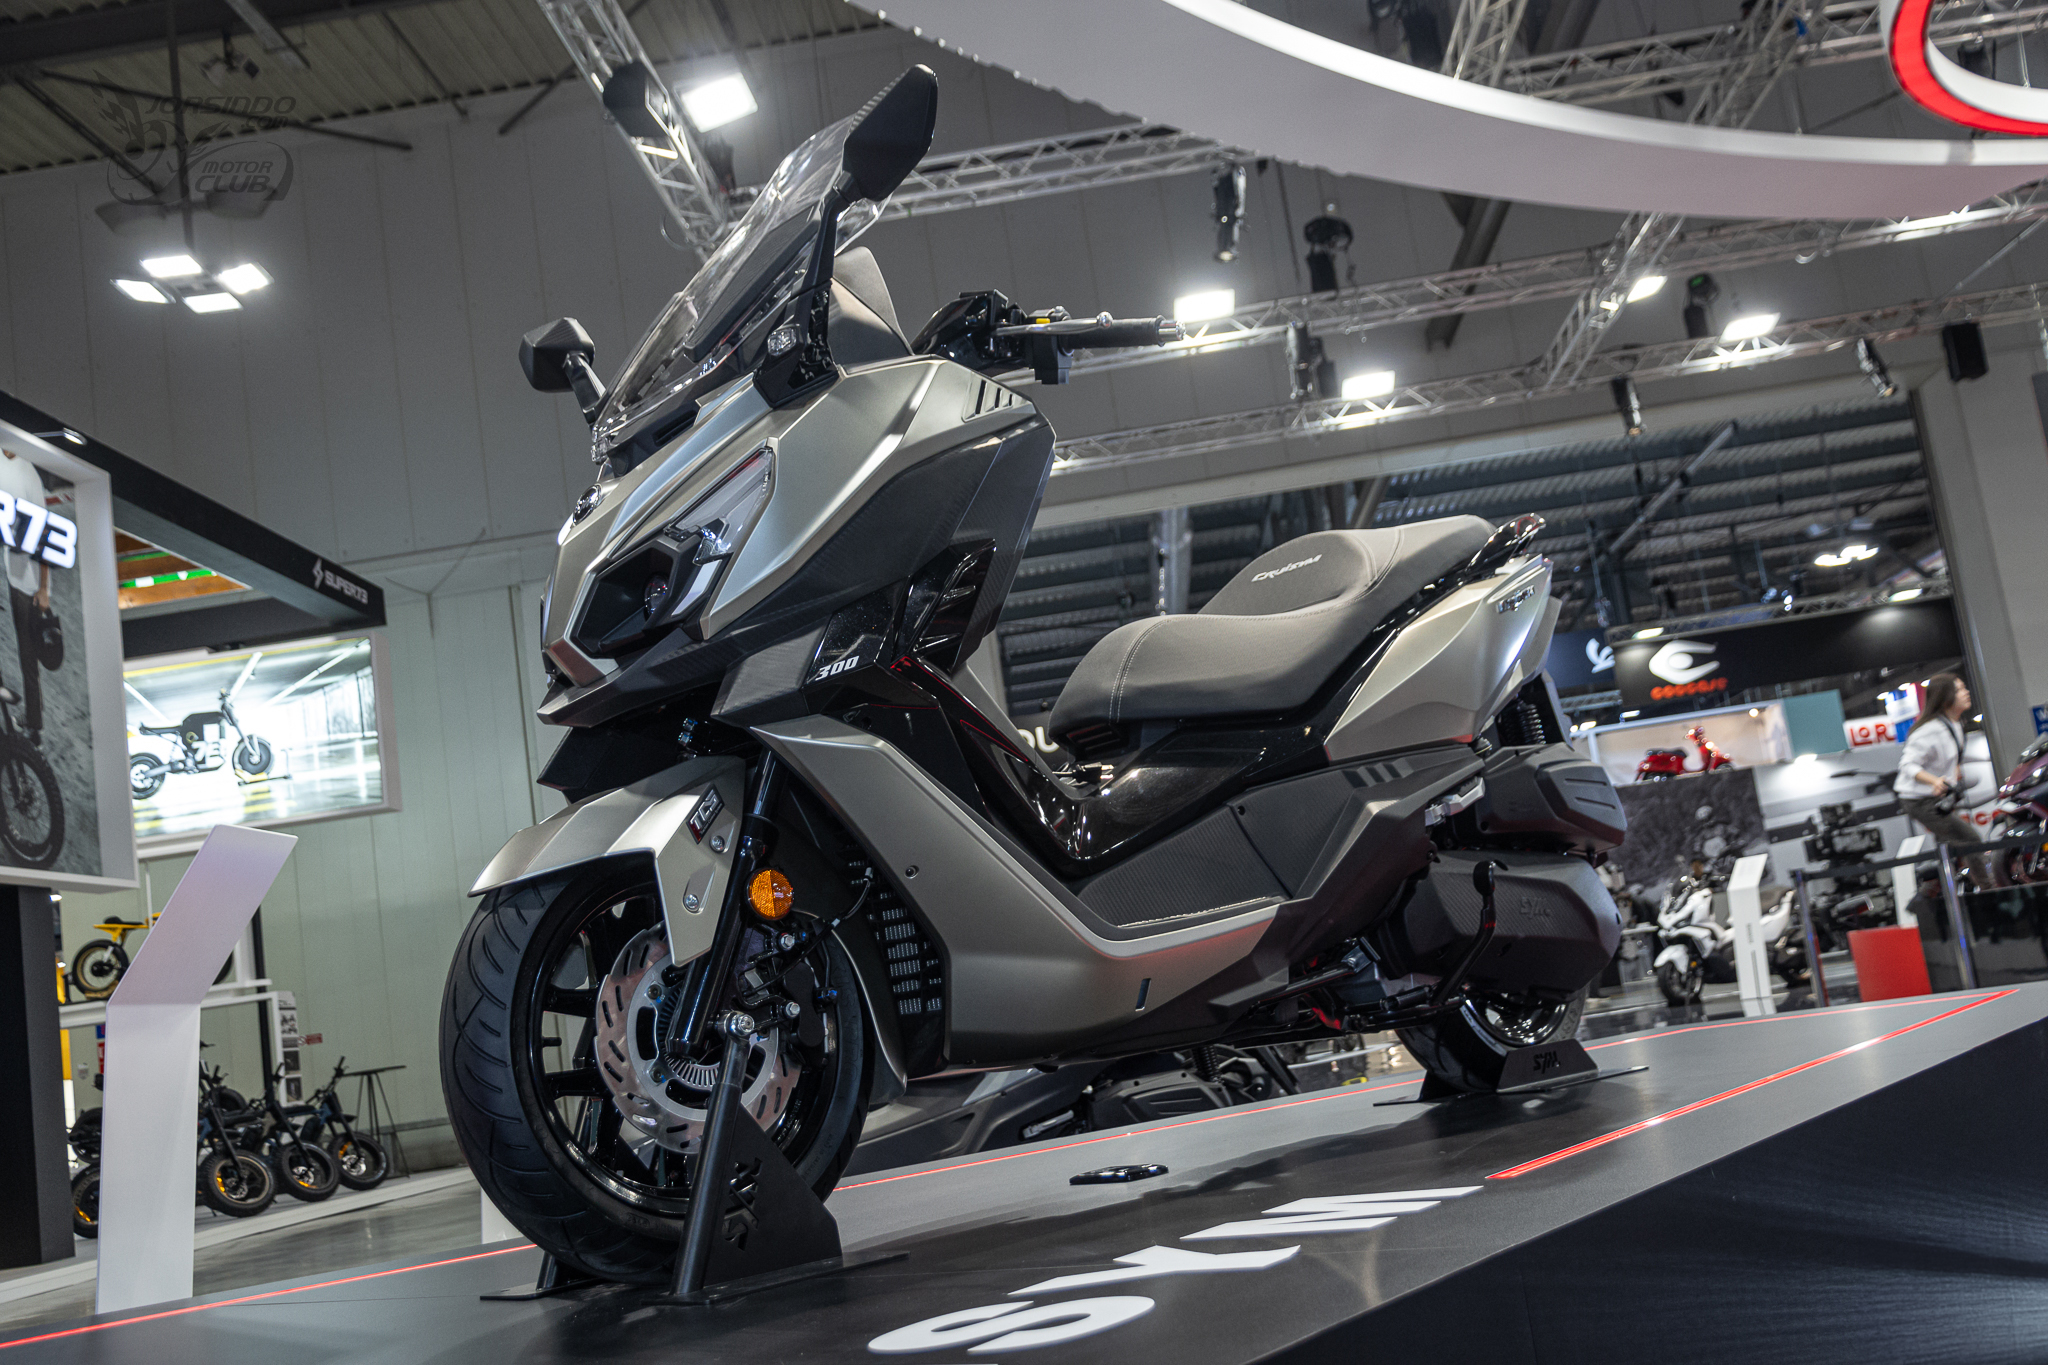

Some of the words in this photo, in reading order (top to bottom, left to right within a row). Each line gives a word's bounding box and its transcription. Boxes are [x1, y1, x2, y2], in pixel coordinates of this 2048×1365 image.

[815, 655, 860, 681] 300
[690, 789, 720, 830] TCS
[868, 1185, 1484, 1354] SYM
